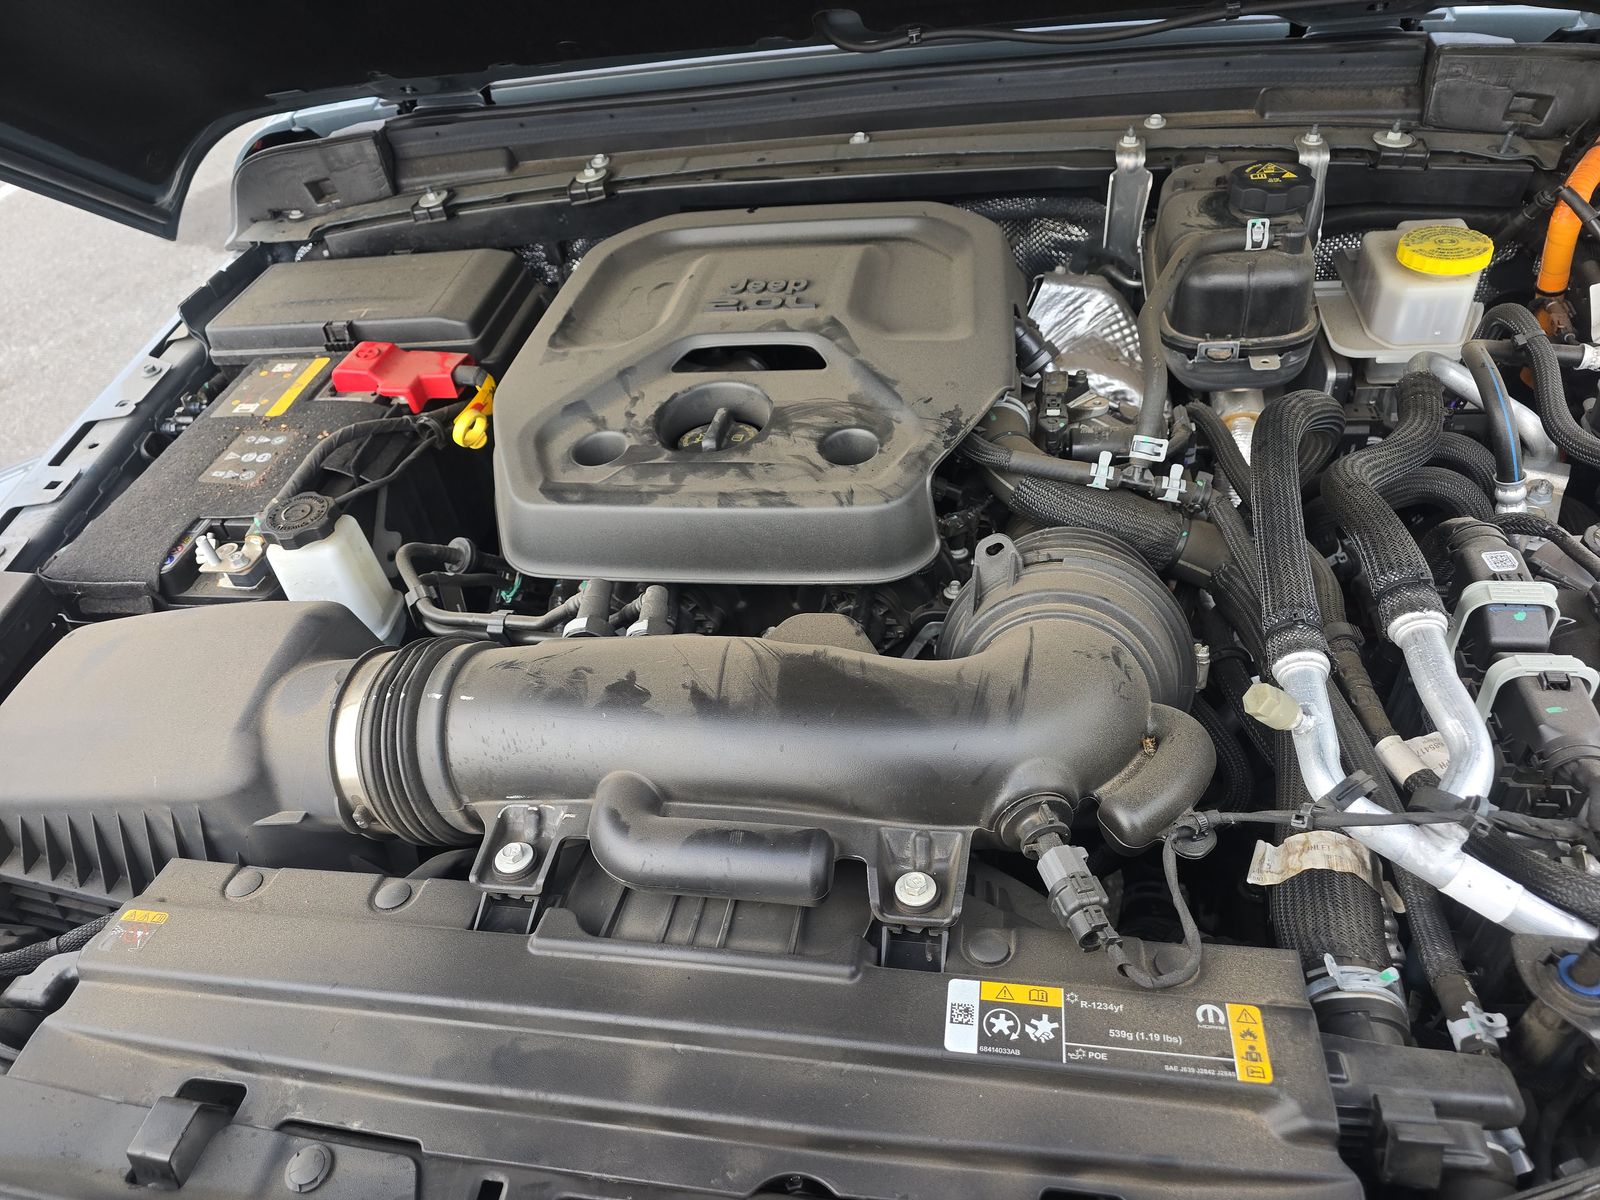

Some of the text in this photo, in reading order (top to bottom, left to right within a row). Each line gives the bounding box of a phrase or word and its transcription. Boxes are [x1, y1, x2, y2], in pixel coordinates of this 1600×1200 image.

[729, 279, 809, 295] Jeep
[703, 296, 818, 312] 2.0L
[1080, 1000, 1124, 1013] R-1234yf
[1108, 1029, 1182, 1045] 539g (1.19 lbs)
[979, 1045, 1021, 1056] 68414033AB
[1088, 1051, 1108, 1060] POE
